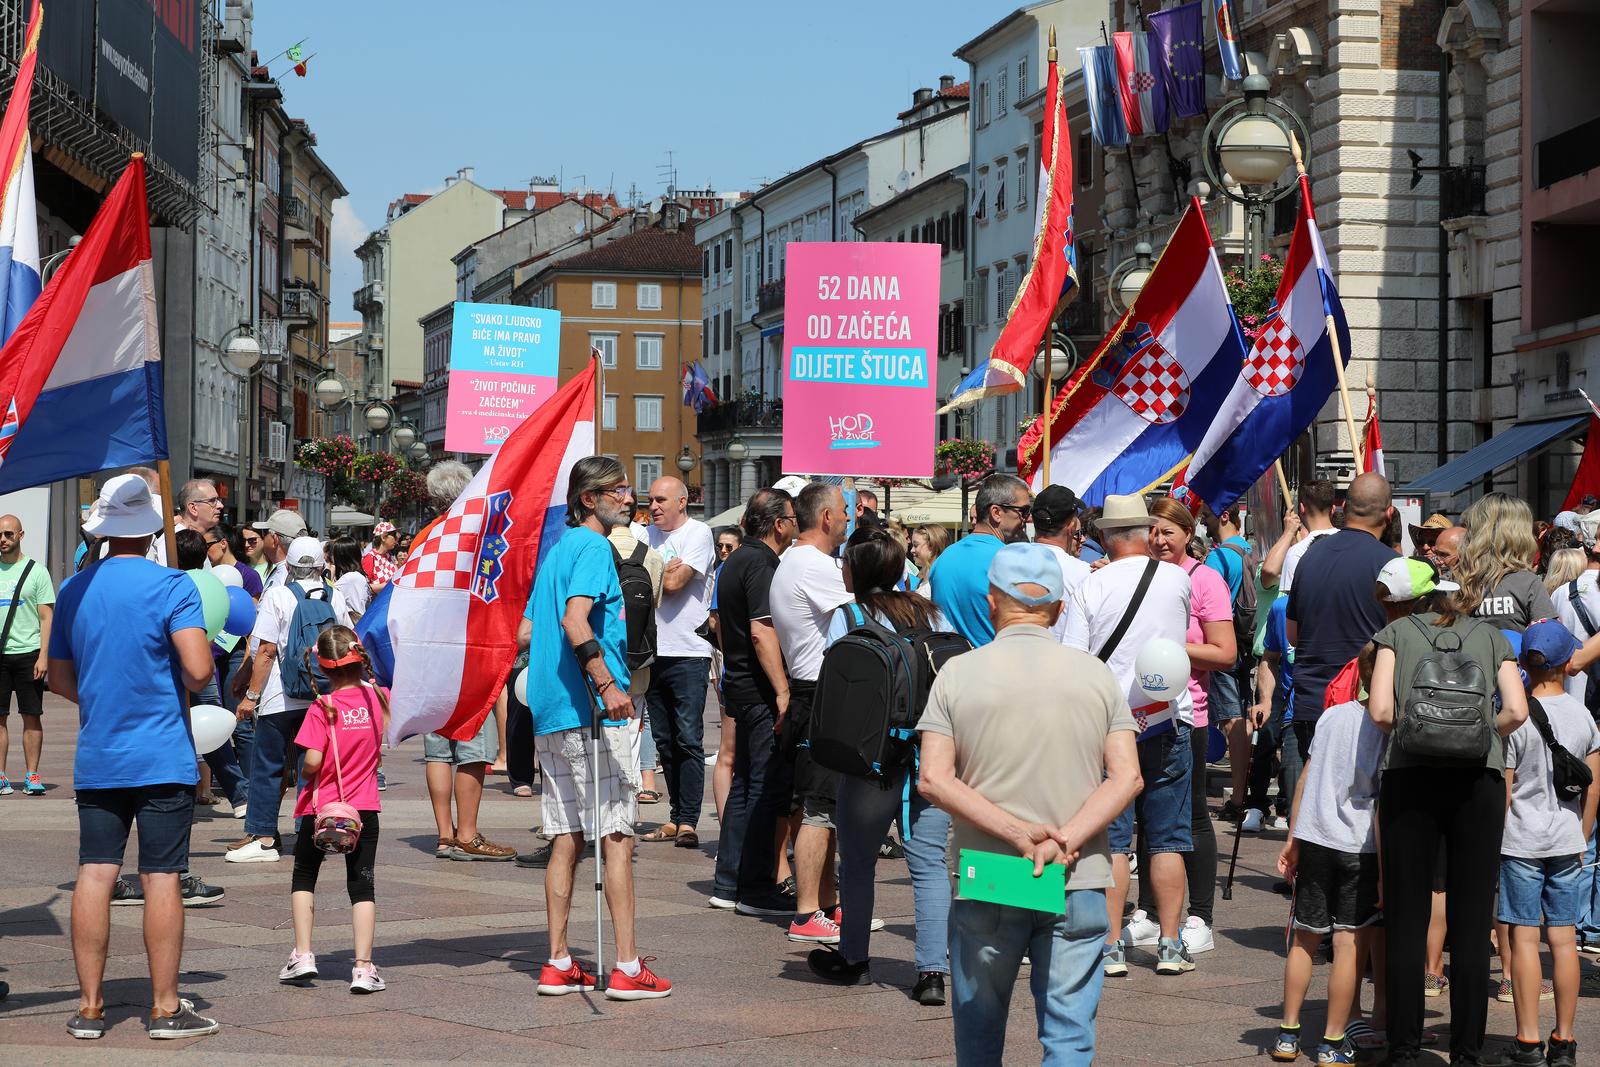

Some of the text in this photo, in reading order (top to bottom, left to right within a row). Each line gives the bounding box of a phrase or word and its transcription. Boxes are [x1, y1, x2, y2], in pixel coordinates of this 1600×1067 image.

[818, 275, 900, 301] 52 DANA
[505, 315, 542, 329] LJUDSKO
[807, 310, 912, 341] OD ZAČEĆA
[494, 330, 511, 342] IMA
[512, 331, 541, 344] PRAVO
[483, 345, 496, 357] NA
[510, 360, 525, 368] RH
[795, 350, 924, 380] DIJETE ŠTUCA
[500, 380, 537, 395] POČINJE
[478, 409, 515, 419] medicinska
[828, 413, 873, 434] HOD
[831, 430, 875, 441] ZA ŽIVOT
[341, 706, 369, 719] HOD
